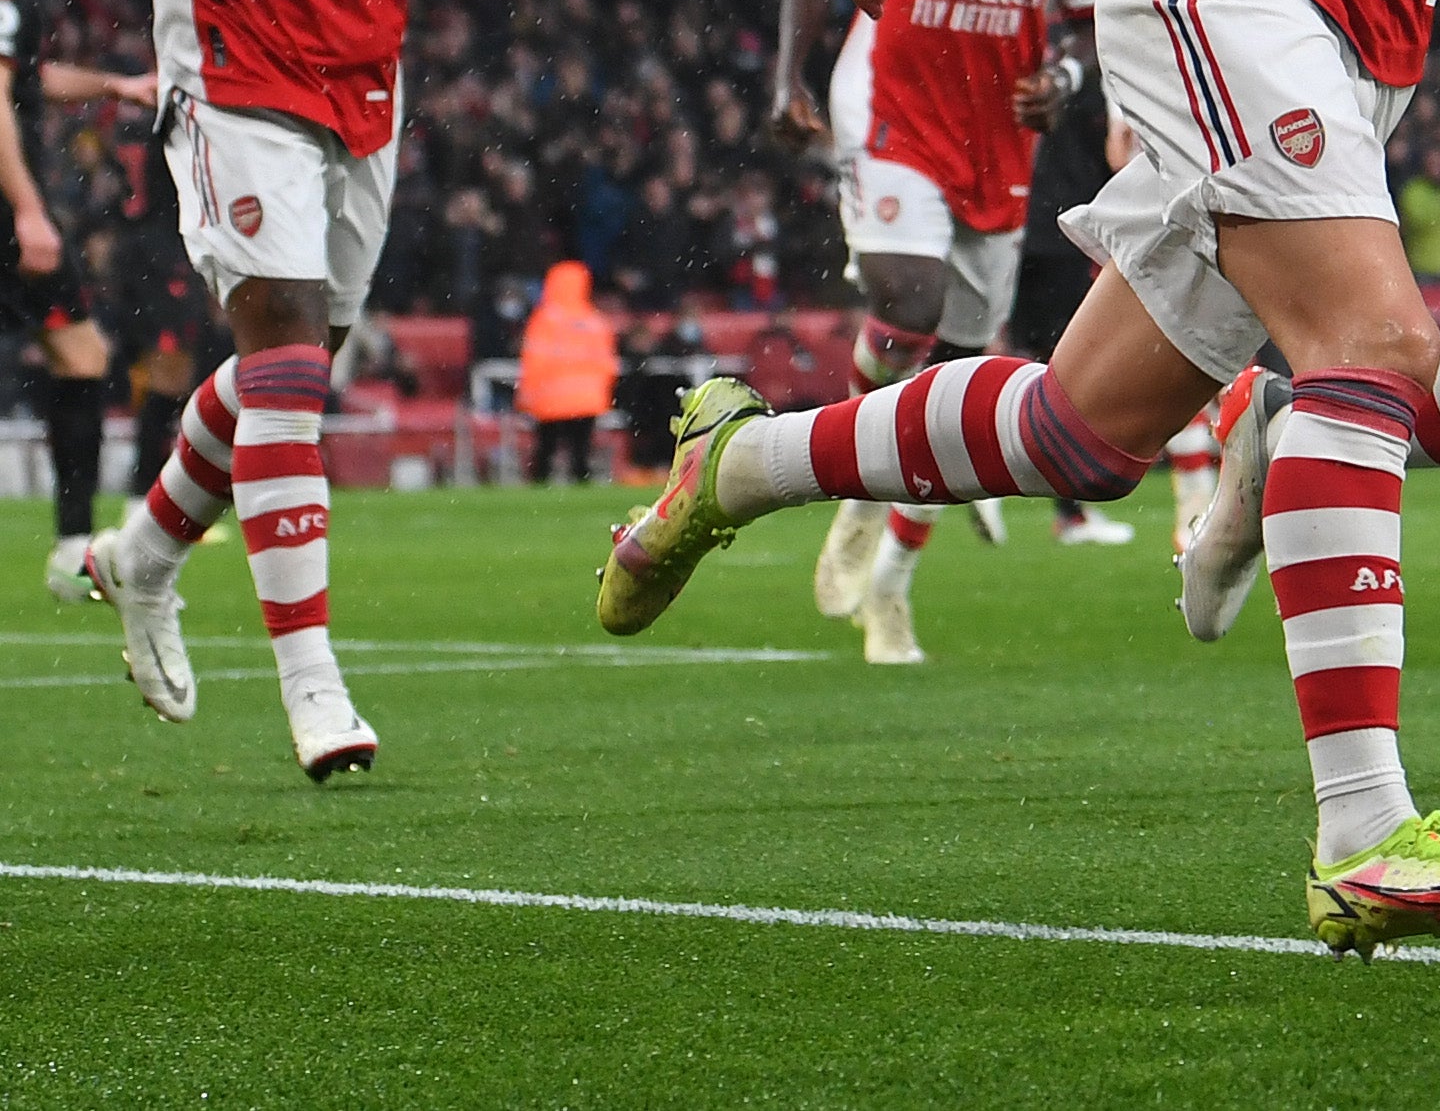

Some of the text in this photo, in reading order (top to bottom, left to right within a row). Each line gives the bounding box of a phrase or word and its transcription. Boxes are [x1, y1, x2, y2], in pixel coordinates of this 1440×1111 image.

[1276, 115, 1316, 136] Arsenal
[274, 513, 327, 537] AFC
[1349, 566, 1405, 591] AF
